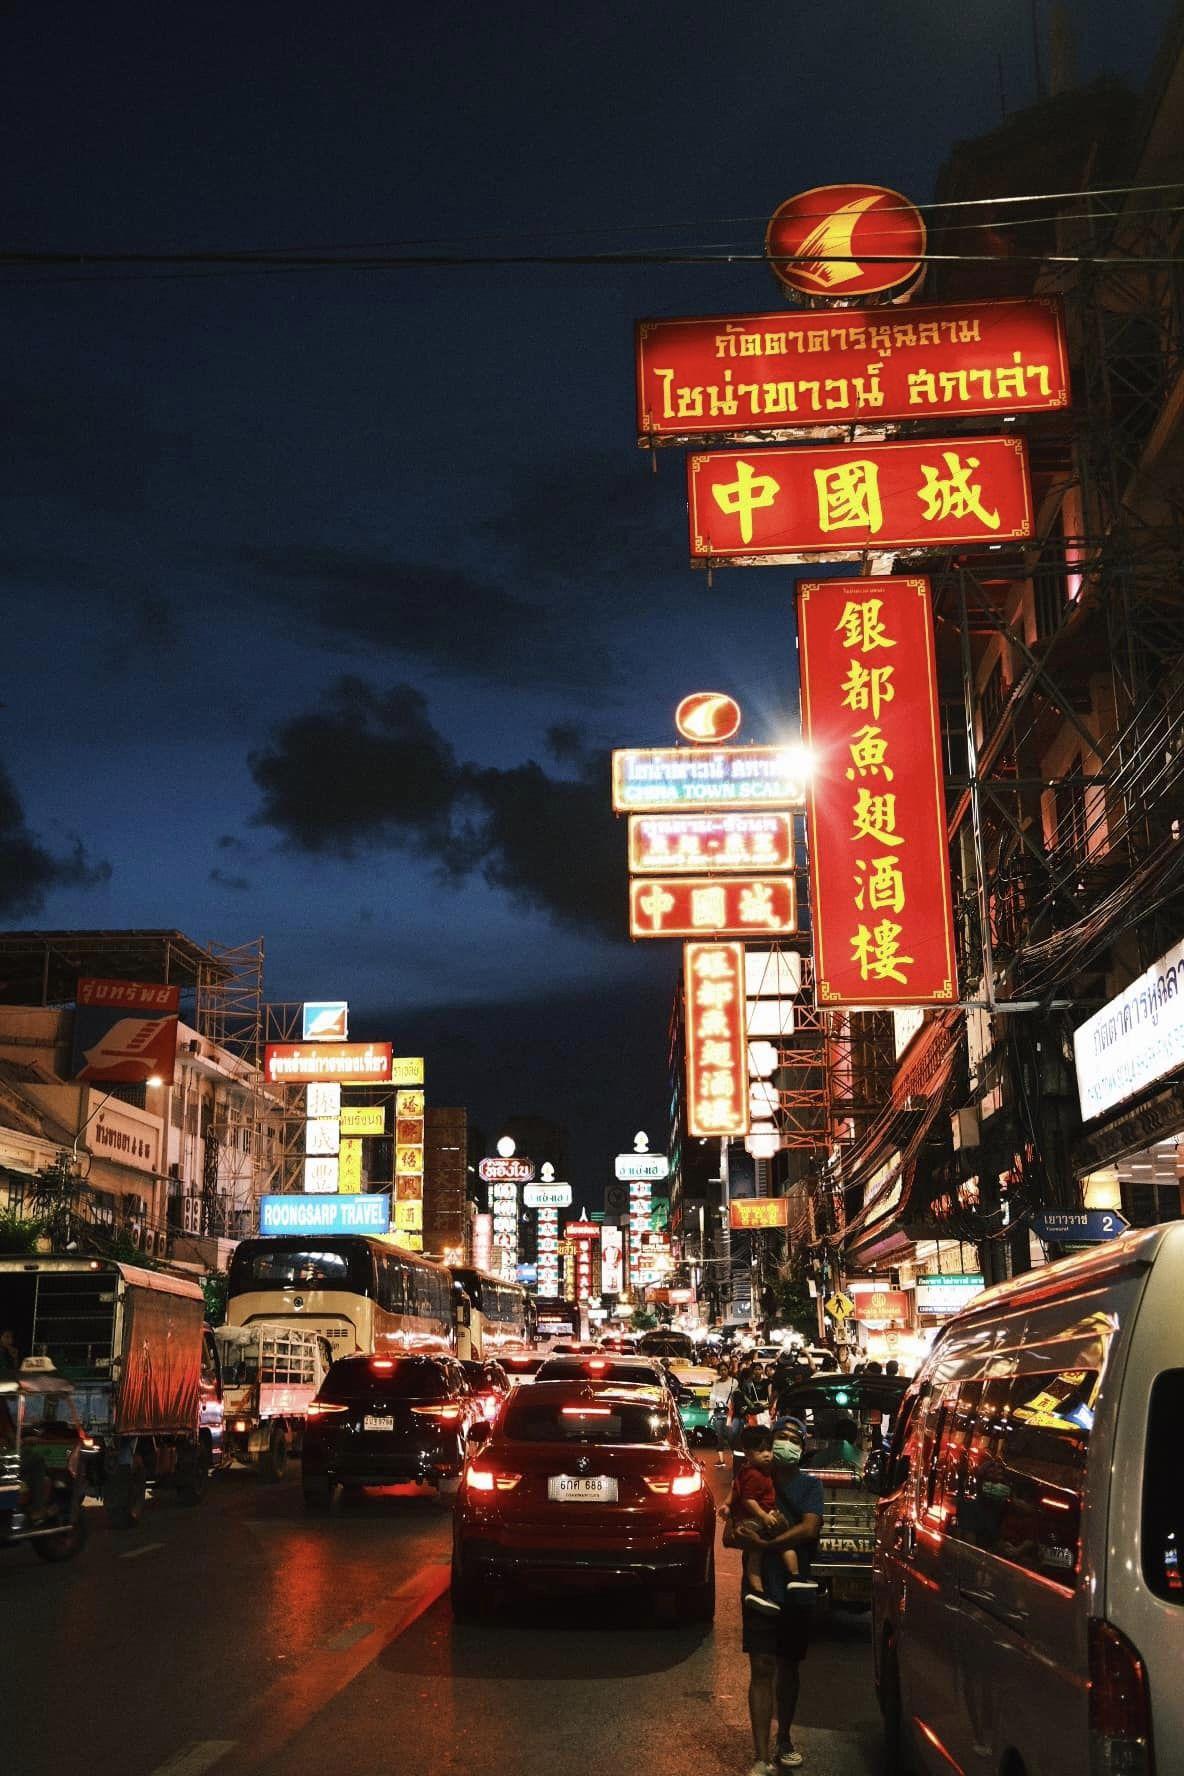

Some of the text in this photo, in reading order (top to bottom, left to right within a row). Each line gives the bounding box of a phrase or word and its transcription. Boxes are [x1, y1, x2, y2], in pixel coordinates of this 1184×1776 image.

[716, 318, 981, 357] ภัตตาคารหูฉลาม
[653, 351, 1053, 418] ไชน่าทาวน์ สกาล่า
[711, 451, 1001, 544] 中國城
[683, 783, 736, 798] TOWN
[835, 600, 914, 984] 銀都魚翅酒樓
[264, 1203, 385, 1227] ROONGSARP TRAVEL
[1044, 1214, 1088, 1225] เยาวราช
[1102, 1216, 1114, 1232] 2
[585, 1480, 603, 1490] 688
